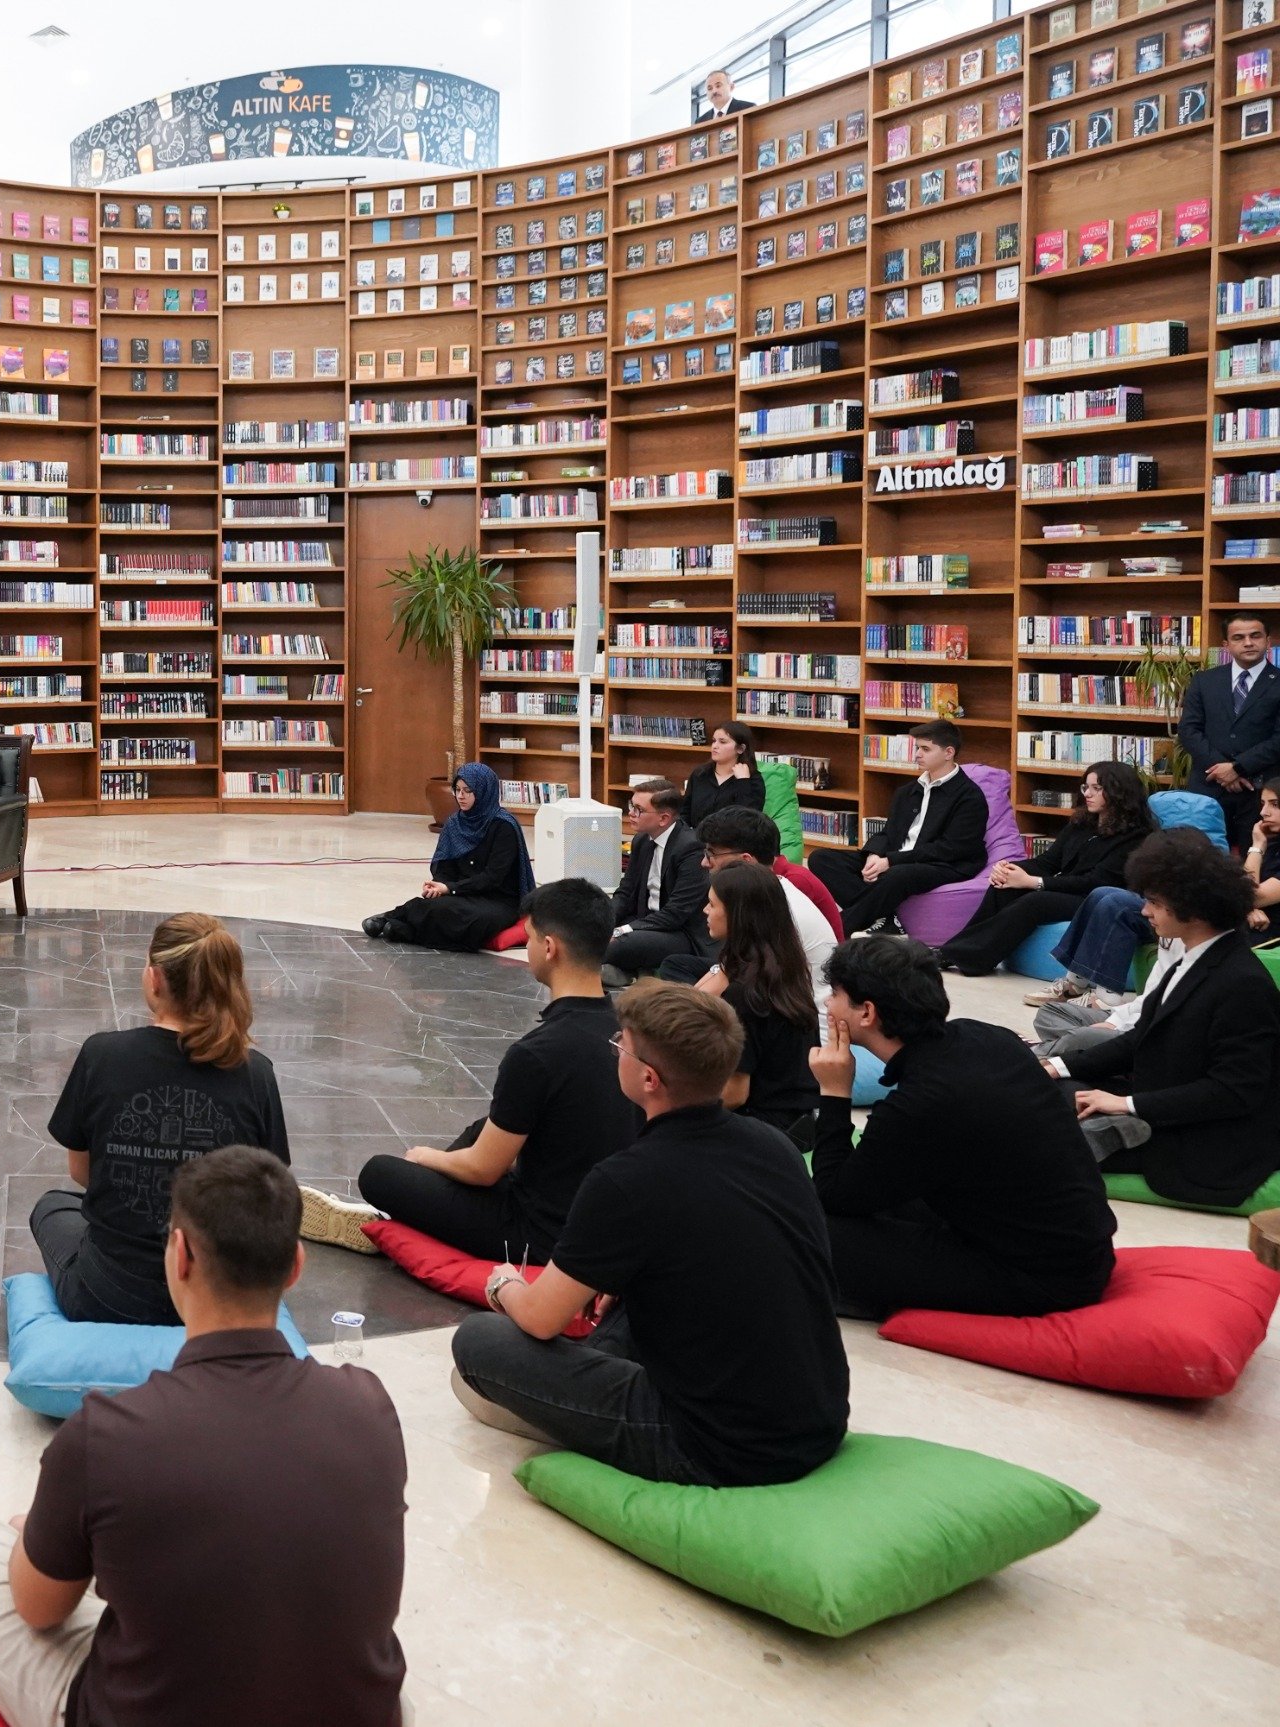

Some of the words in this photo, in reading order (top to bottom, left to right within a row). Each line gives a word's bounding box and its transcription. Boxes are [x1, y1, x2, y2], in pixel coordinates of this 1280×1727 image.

[1236, 64, 1268, 81] AFTER
[231, 97, 282, 117] ALTIN
[288, 95, 332, 113] KAFE
[875, 454, 1006, 492] Altındağ
[106, 1143, 141, 1157] ERMAN
[143, 1147, 179, 1160] ILICAK
